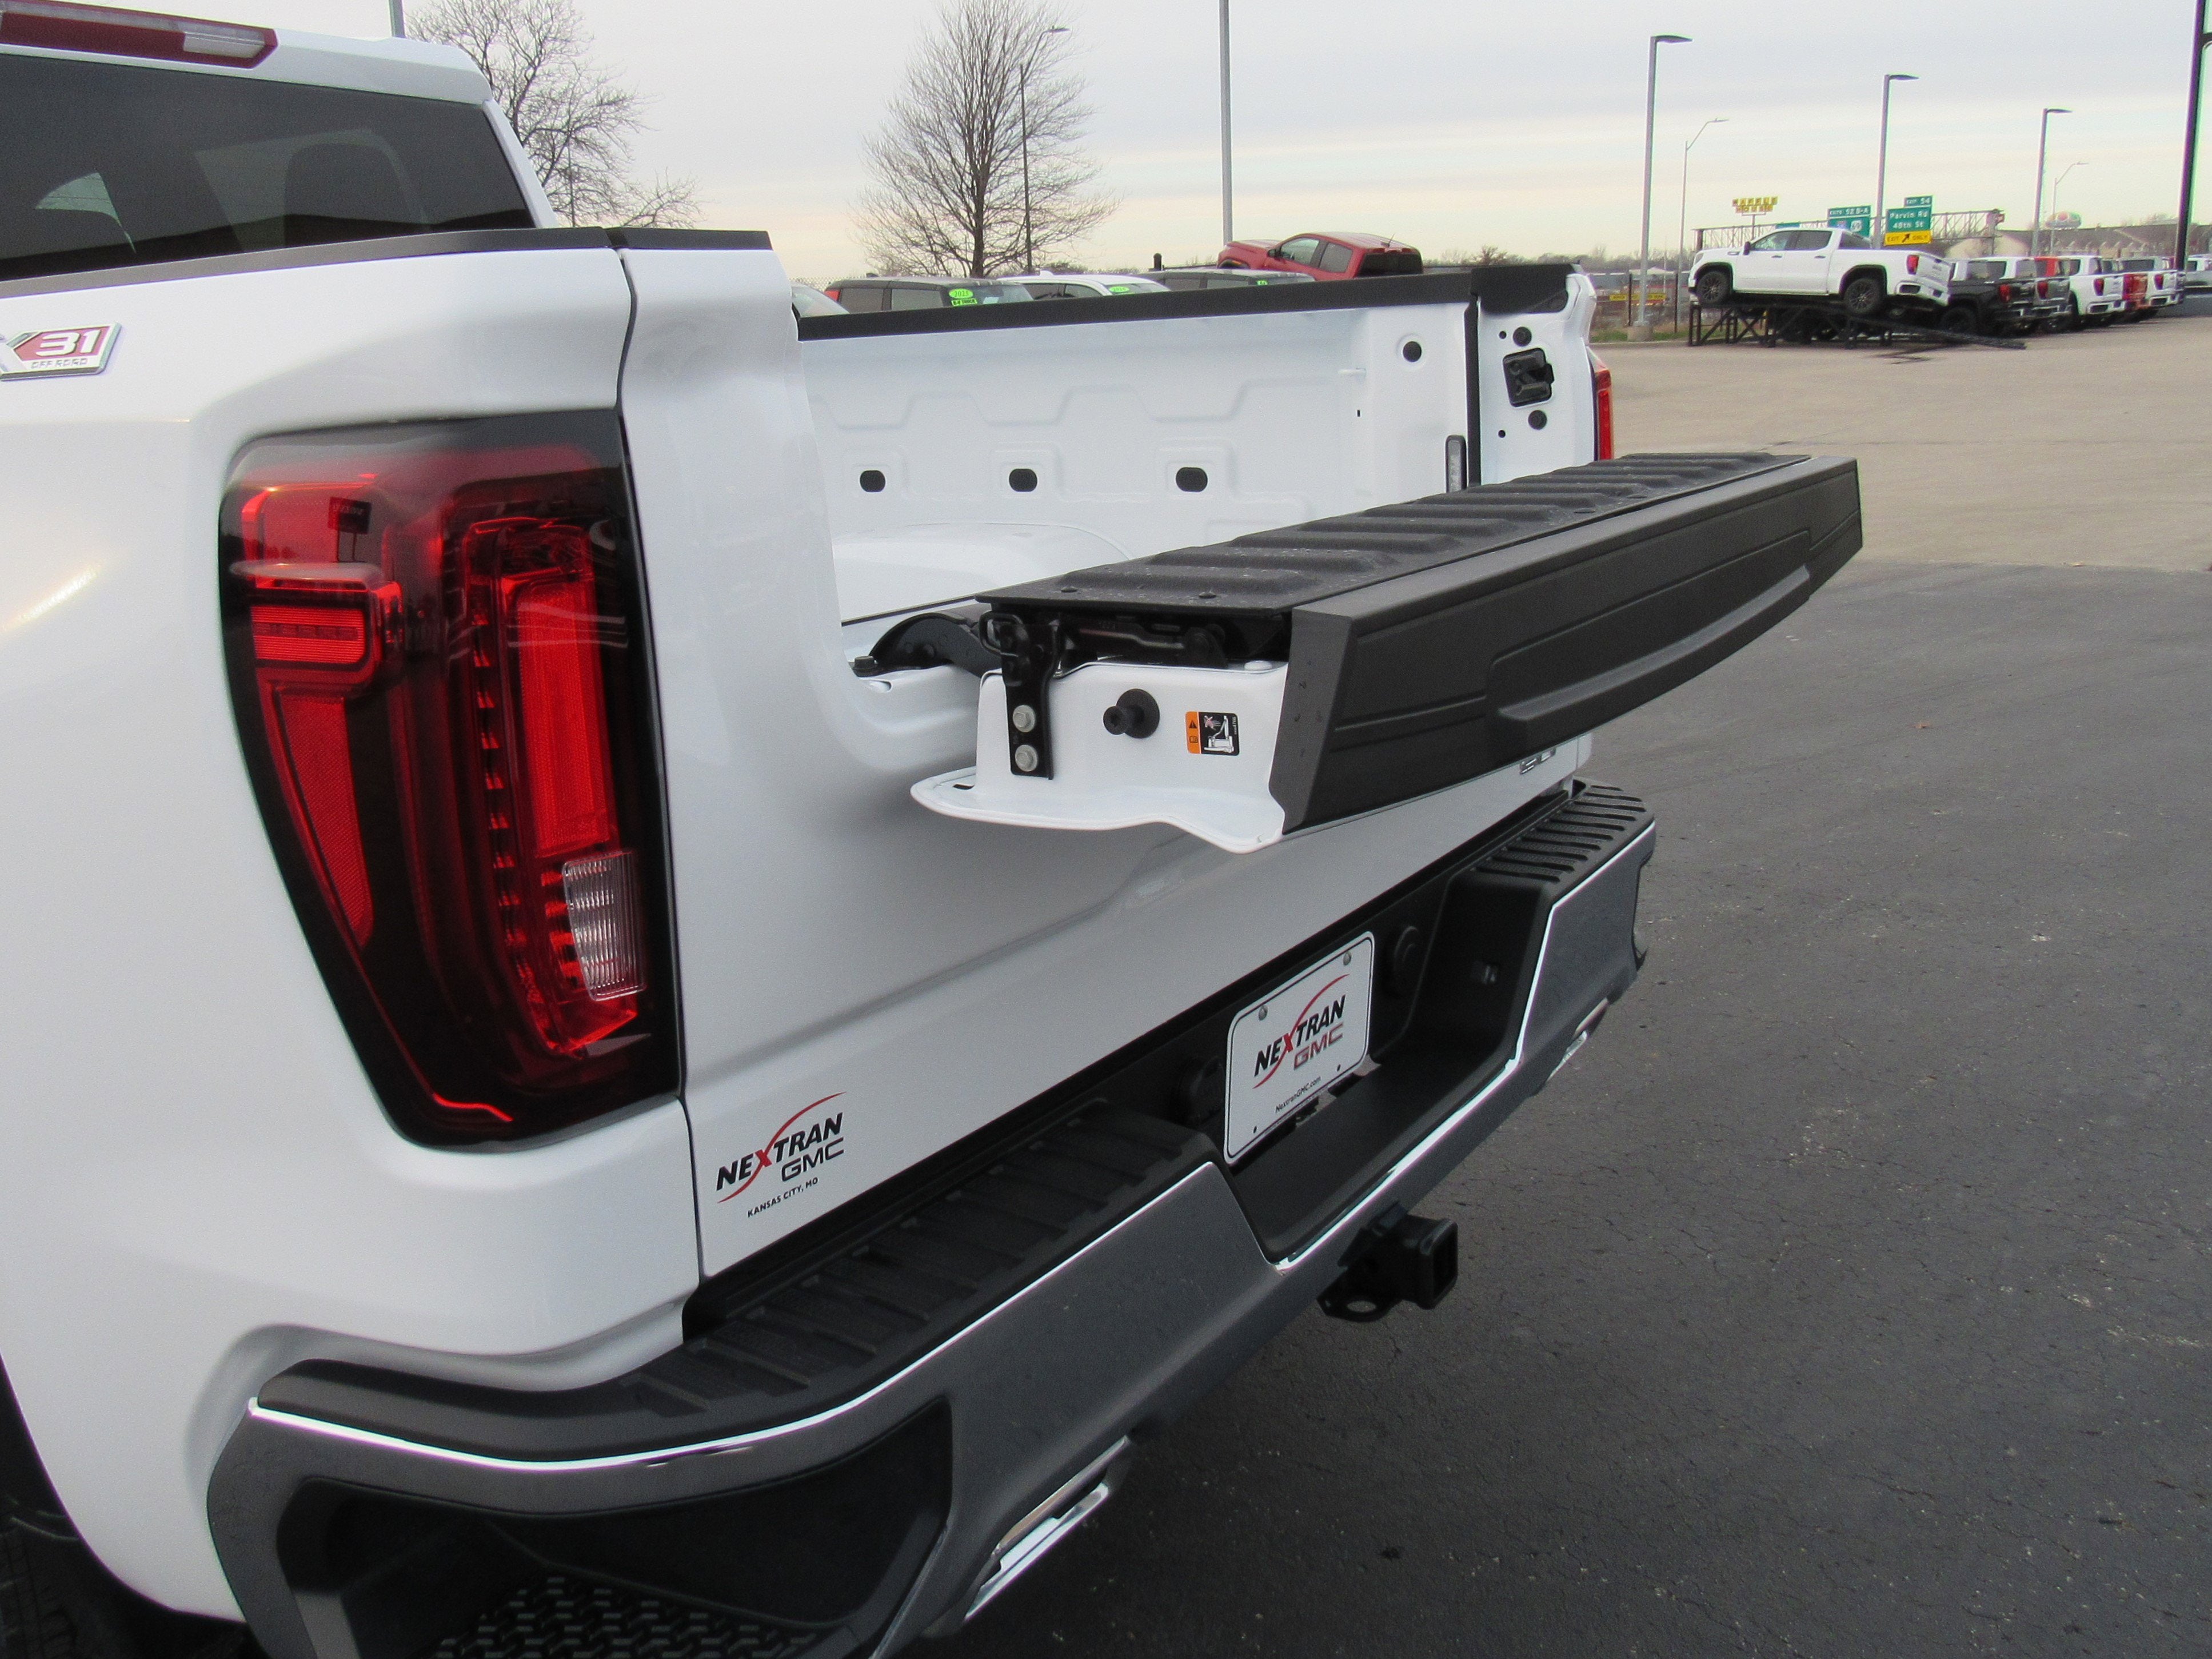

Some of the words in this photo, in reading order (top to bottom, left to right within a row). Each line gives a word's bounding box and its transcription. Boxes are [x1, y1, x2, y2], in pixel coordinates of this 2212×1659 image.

[55, 358, 88, 367] ROAD
[1254, 994, 1345, 1076] NEXTRAN
[1294, 1022, 1343, 1070] GMC
[716, 1112, 843, 1191] NEXTRAN
[781, 1137, 844, 1182] GMC
[747, 1195, 781, 1218] KANSAS
[783, 1185, 804, 1199] CITY,
[805, 1177, 818, 1189] MO
